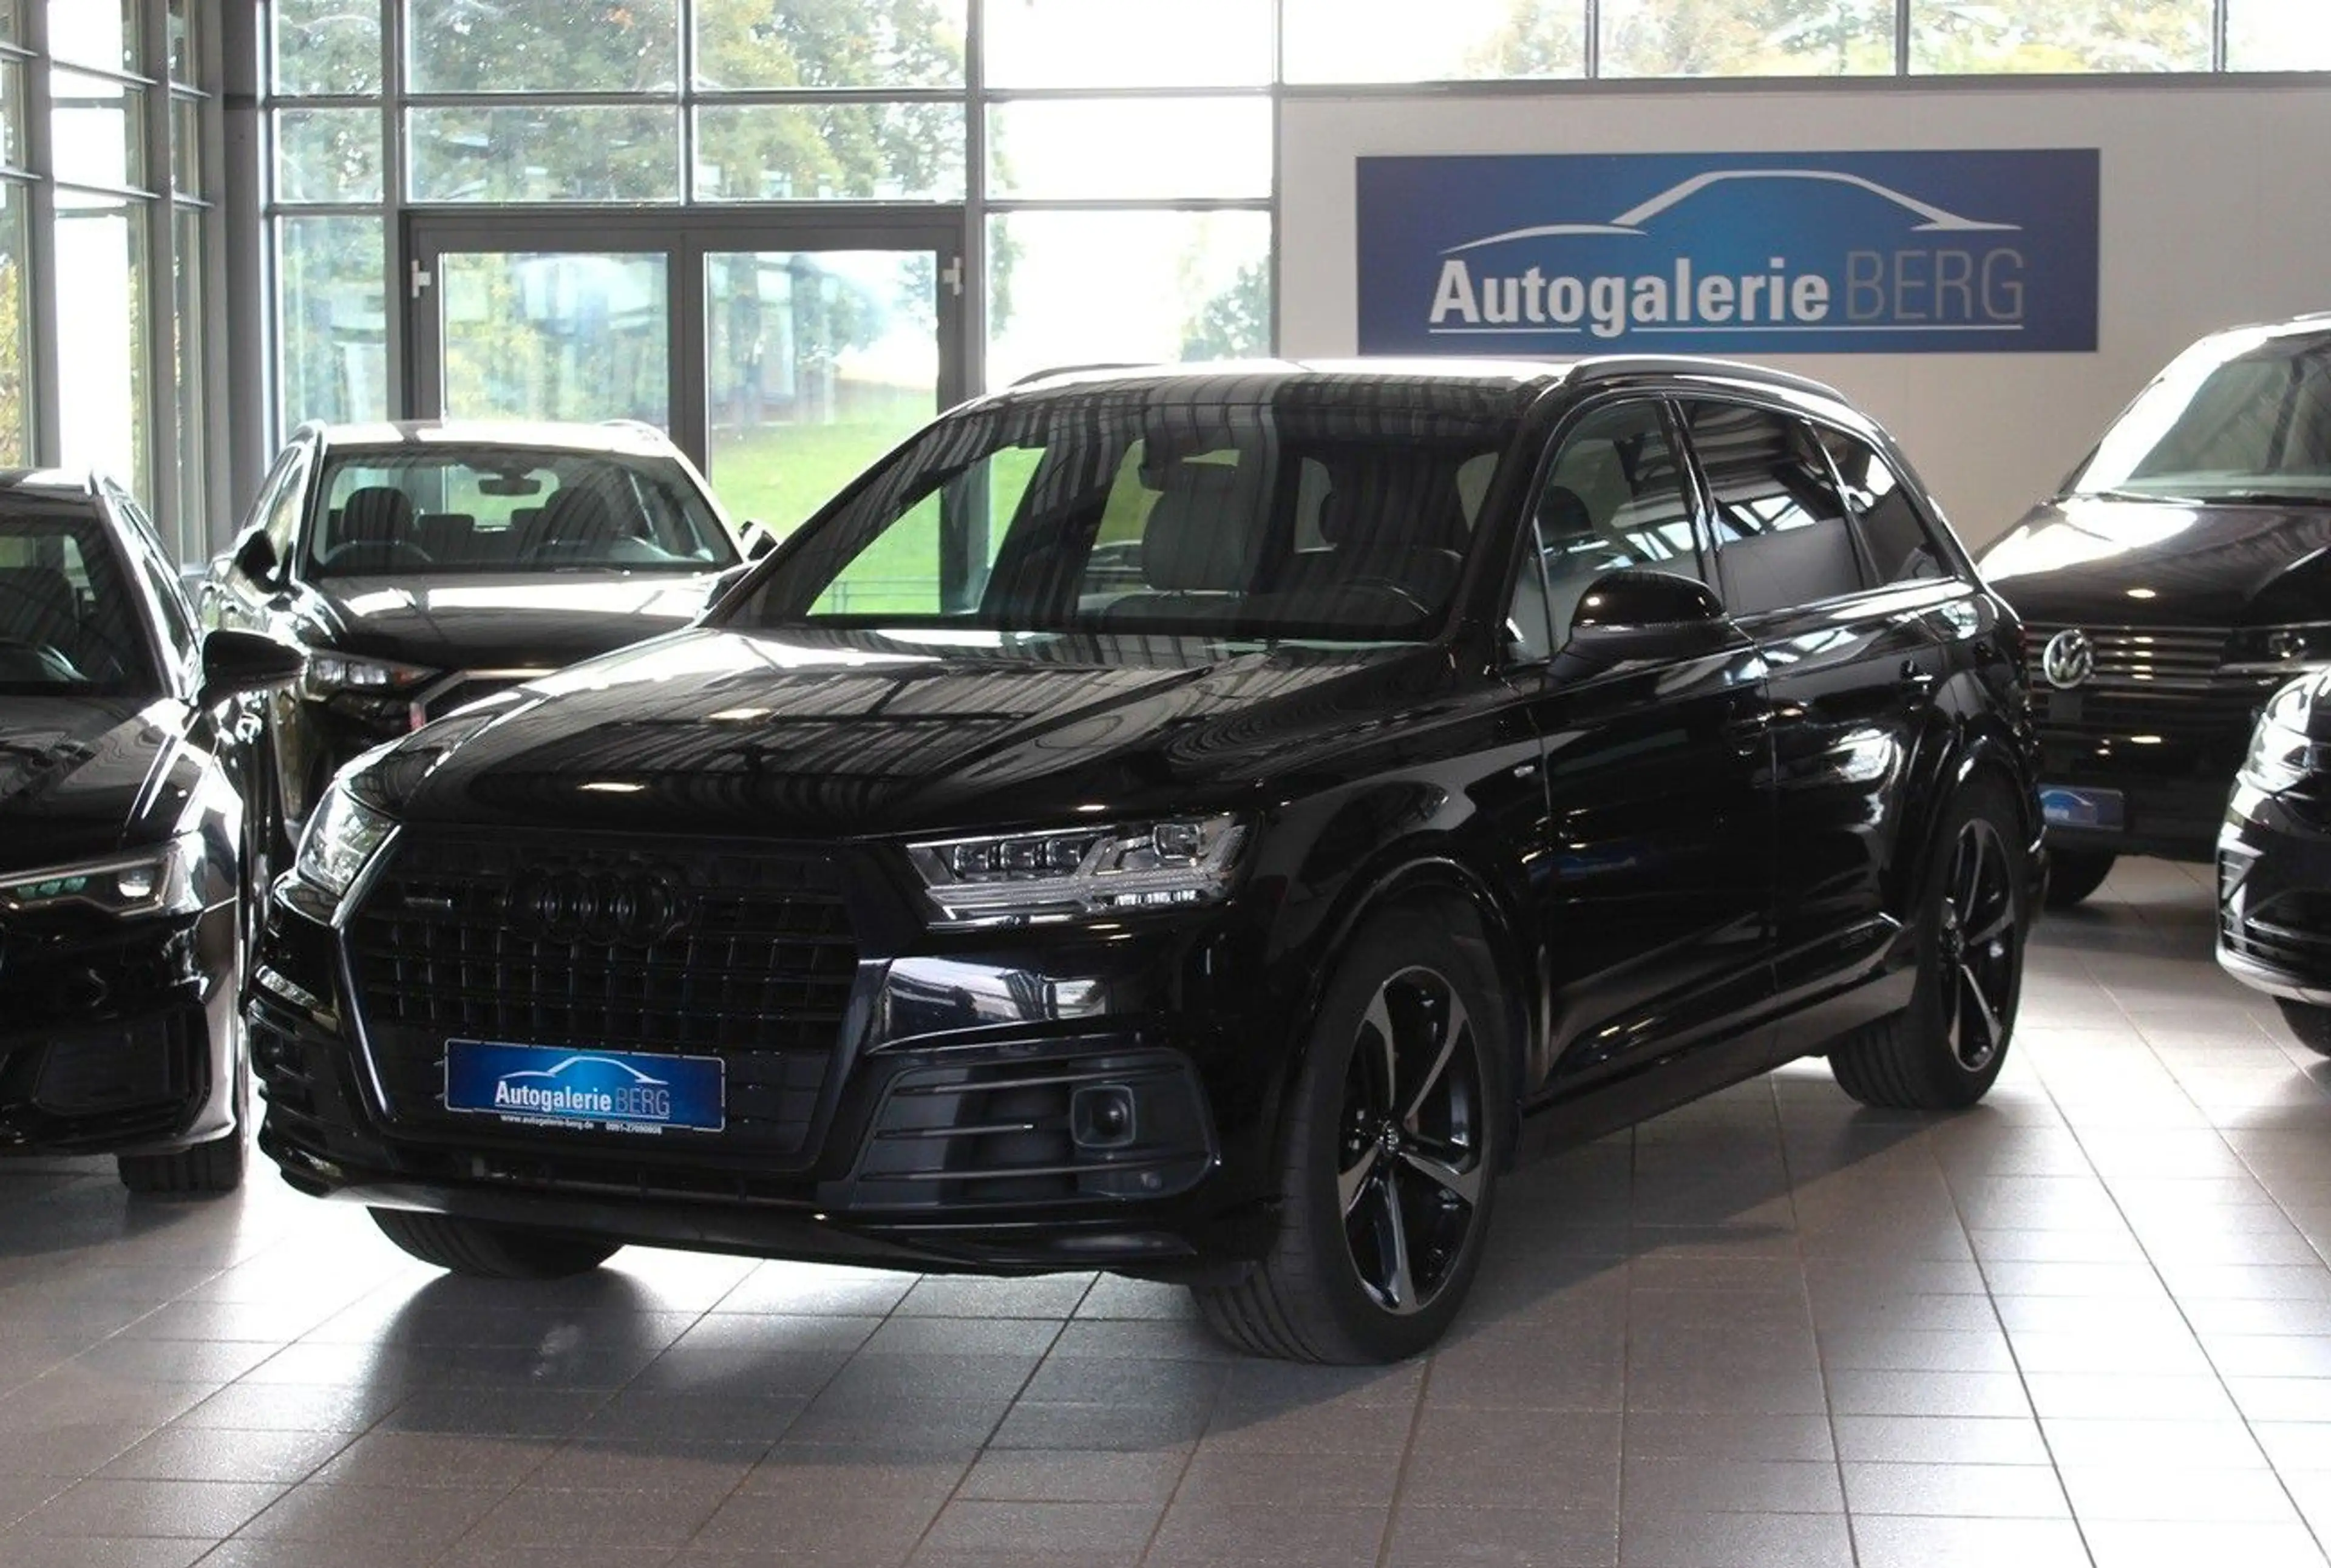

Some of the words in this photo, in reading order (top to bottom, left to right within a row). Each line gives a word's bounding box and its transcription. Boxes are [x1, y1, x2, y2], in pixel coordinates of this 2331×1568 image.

[1430, 258, 1829, 338] Autogalerie
[1846, 248, 2023, 320] BERG
[495, 1080, 612, 1112] Autogalerie
[615, 1087, 670, 1116] BERG
